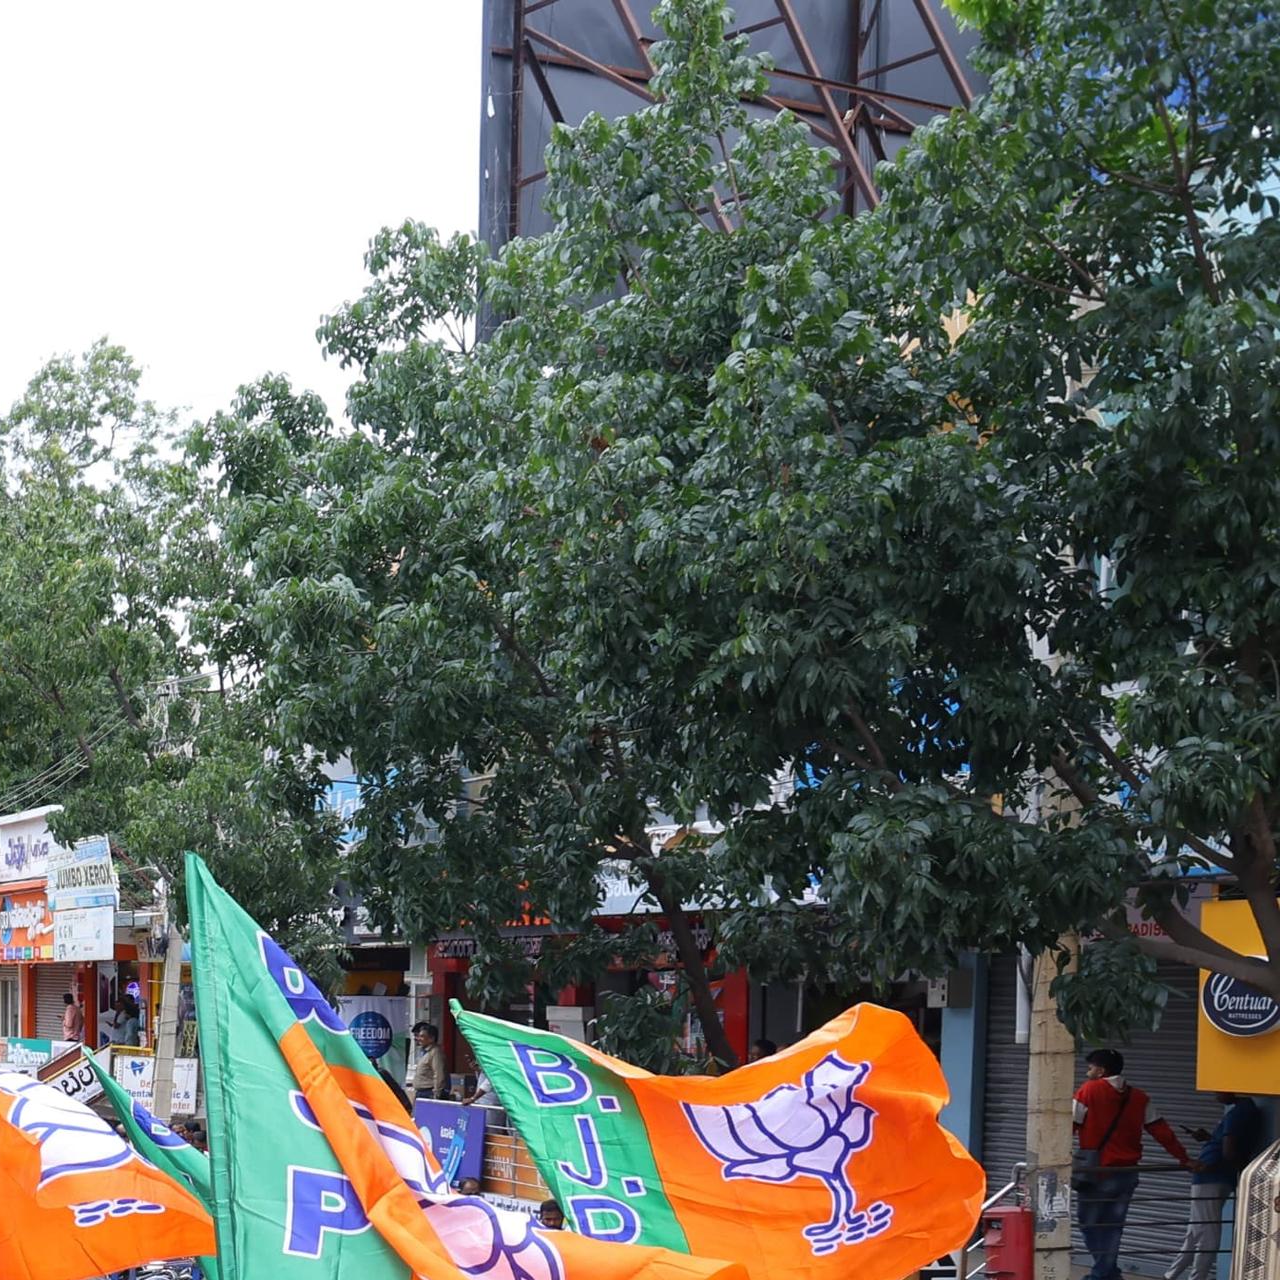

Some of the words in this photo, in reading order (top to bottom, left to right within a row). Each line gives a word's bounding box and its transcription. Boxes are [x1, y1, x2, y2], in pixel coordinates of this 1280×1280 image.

[57, 868, 82, 889] JUMBO
[85, 863, 112, 885] XEROX
[1210, 973, 1275, 1012] Centuar
